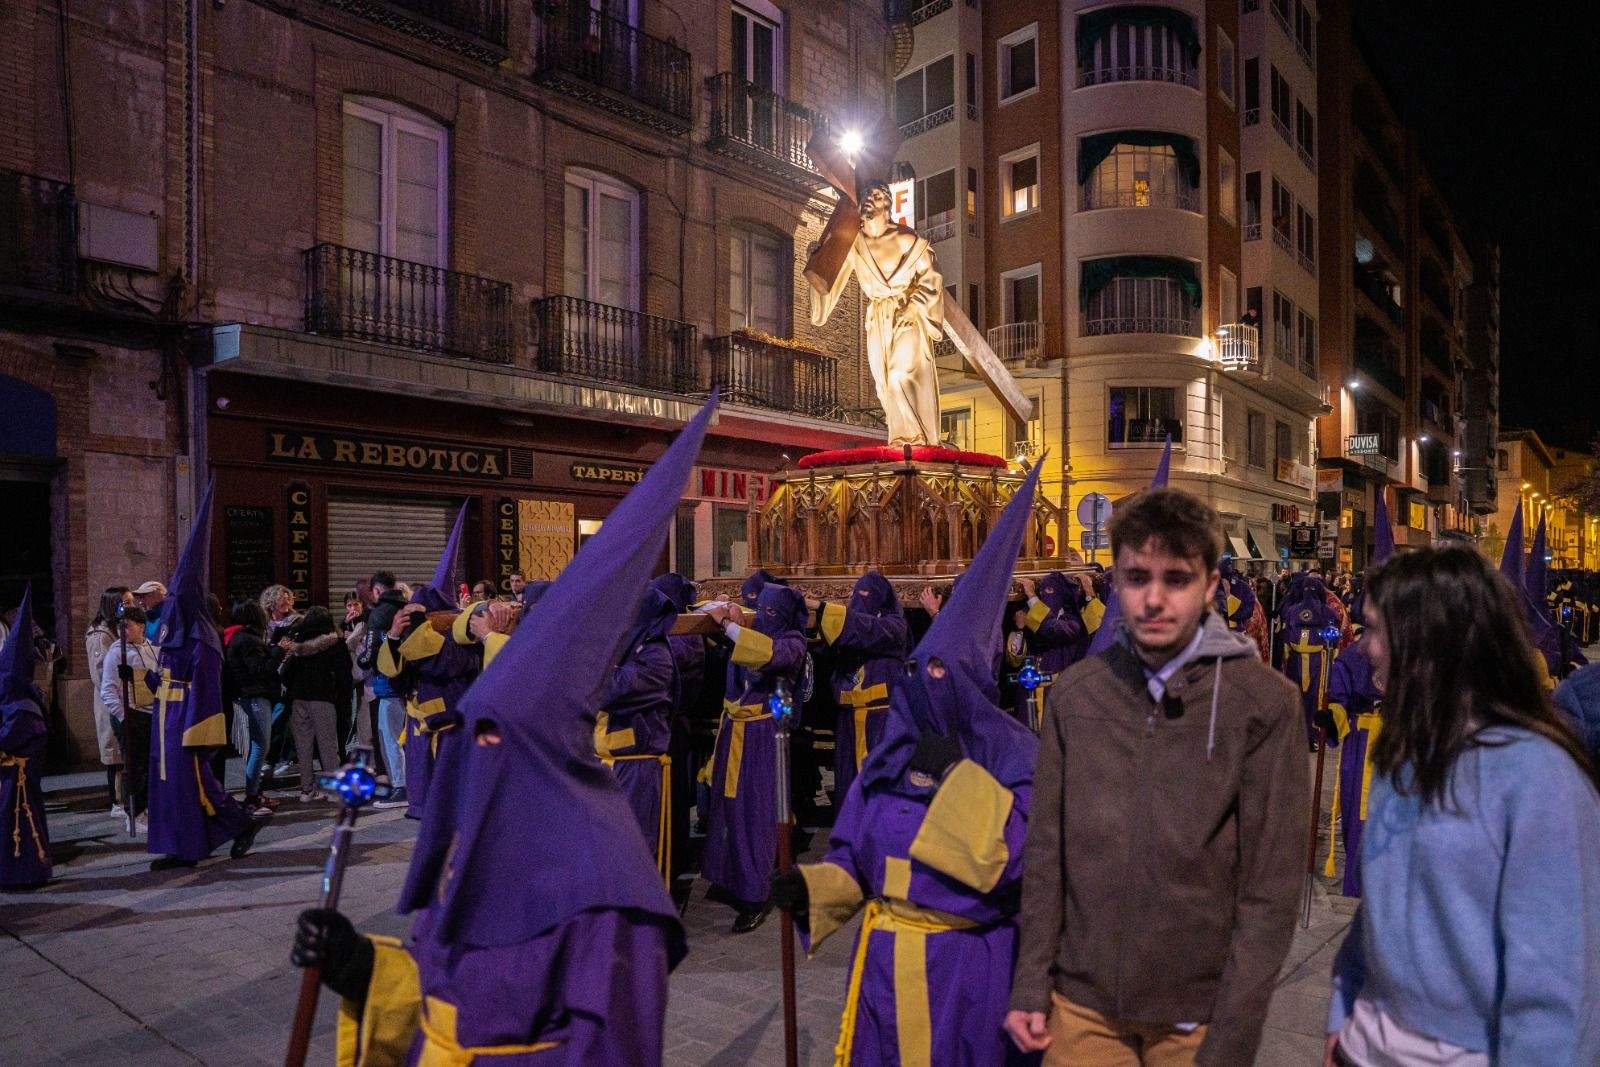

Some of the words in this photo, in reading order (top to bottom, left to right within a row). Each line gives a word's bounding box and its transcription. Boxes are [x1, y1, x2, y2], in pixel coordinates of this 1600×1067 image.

[271, 433, 321, 460] LA
[333, 439, 500, 475] REBOTICA
[1350, 436, 1378, 449] DUVISA
[291, 491, 308, 602] CAFETE
[501, 503, 514, 592] CERVEC
